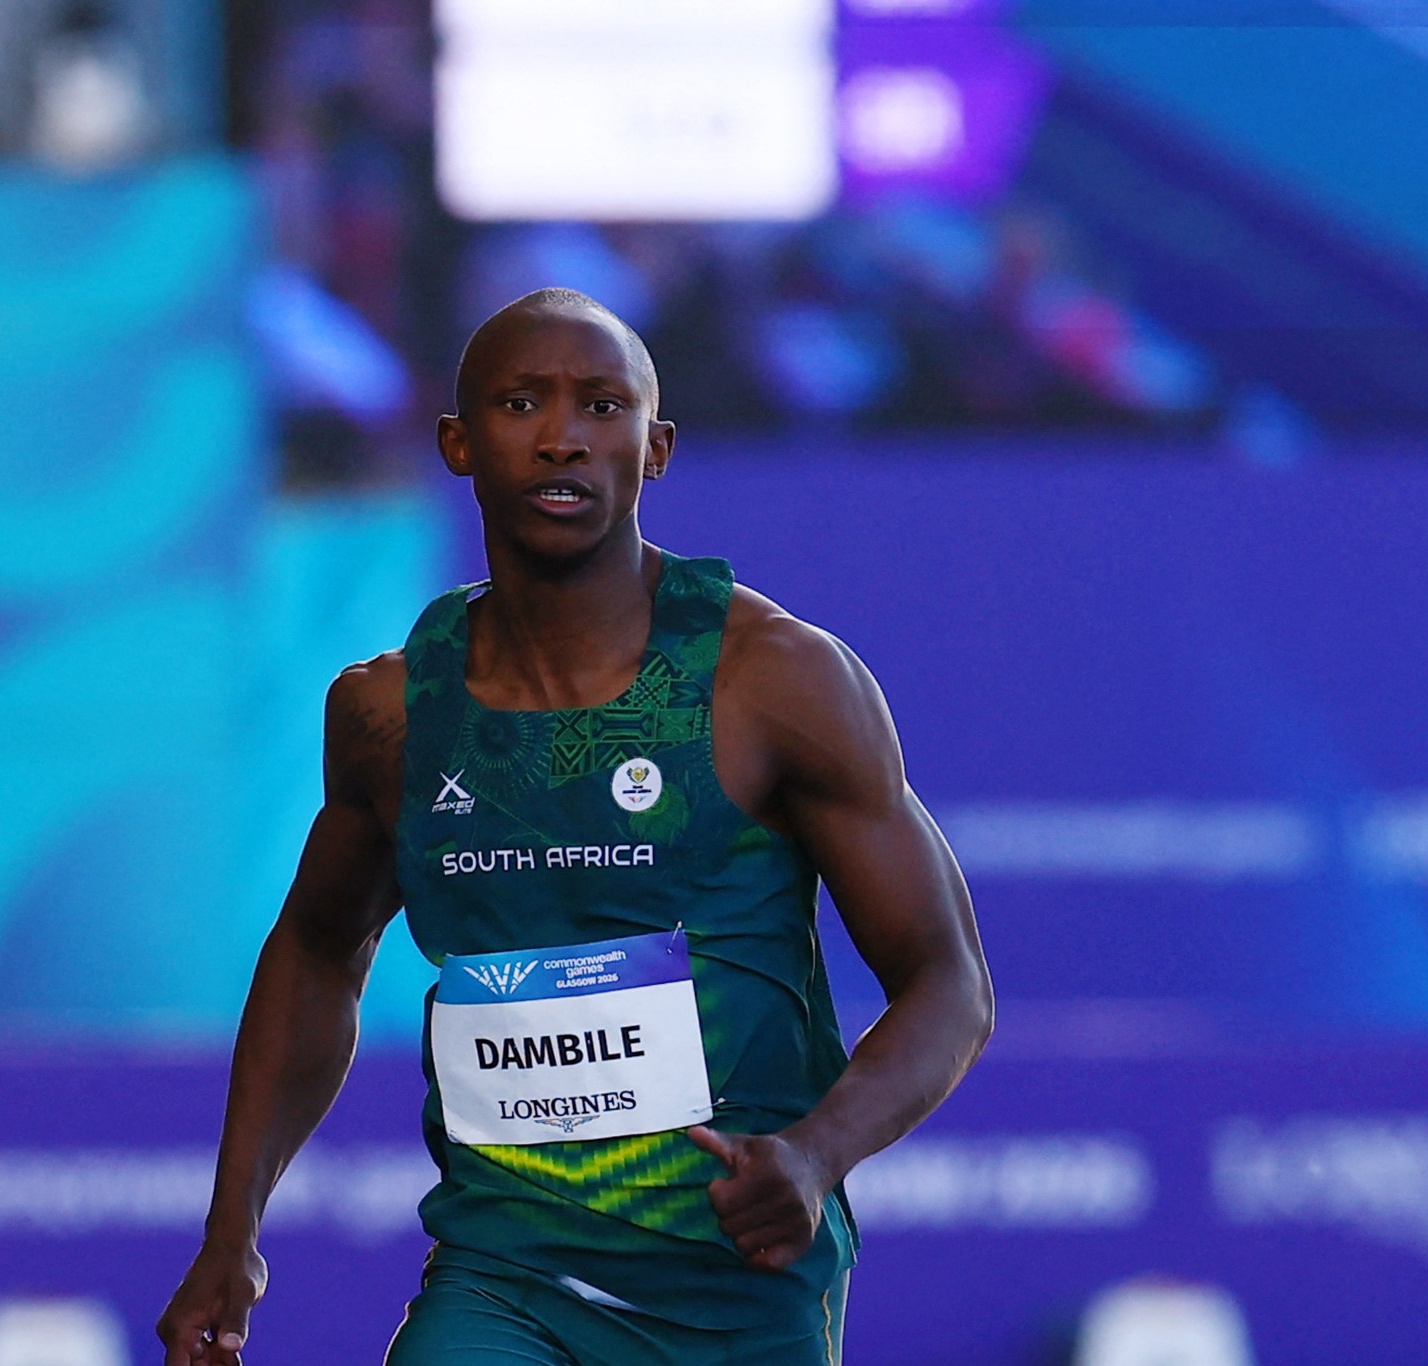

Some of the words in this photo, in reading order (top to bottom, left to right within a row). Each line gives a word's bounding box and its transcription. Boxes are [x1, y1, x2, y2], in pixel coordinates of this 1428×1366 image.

[442, 848, 535, 876] SOUTH
[545, 844, 655, 869] AFRICA
[543, 949, 627, 971] commonwealth
[565, 963, 605, 979] games
[556, 976, 597, 989] GLASGOW
[597, 973, 619, 985] 2026
[474, 1024, 646, 1071] DAMBILE
[499, 1090, 637, 1121] LONGINES
